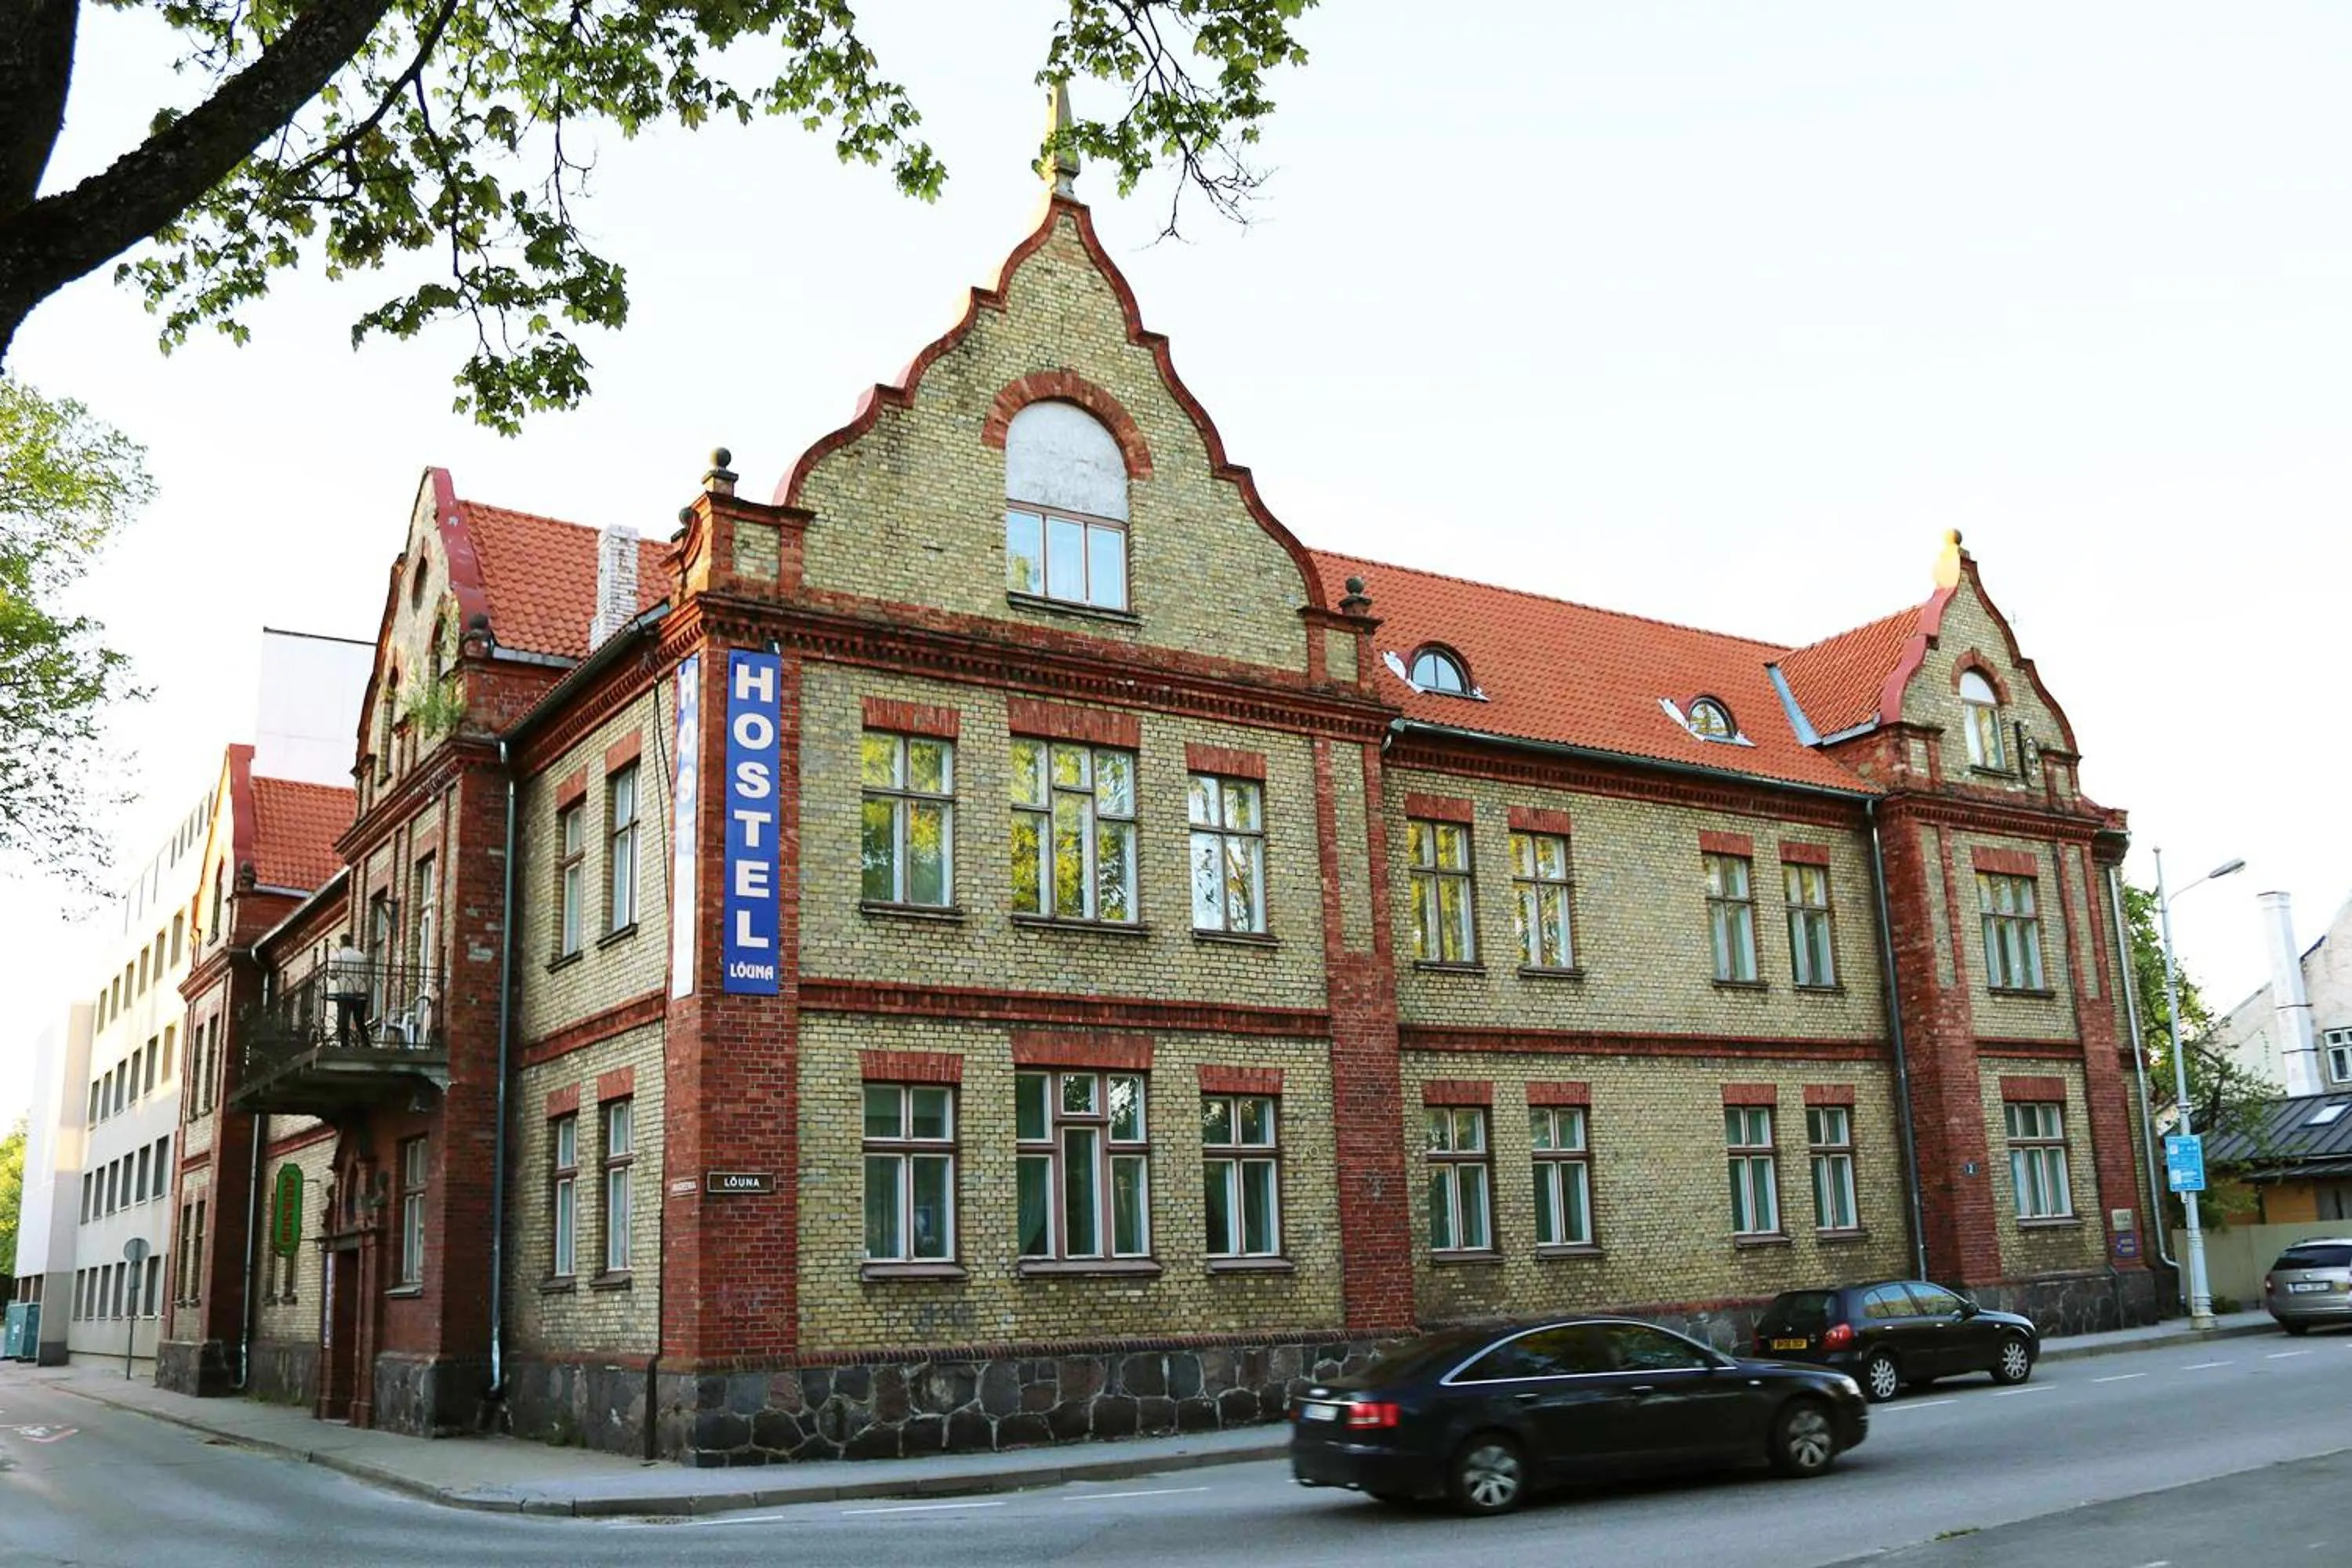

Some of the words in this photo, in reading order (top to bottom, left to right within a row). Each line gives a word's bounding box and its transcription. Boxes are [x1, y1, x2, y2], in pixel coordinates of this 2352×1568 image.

[676, 666, 696, 951] HOST
[733, 665, 774, 948] HOSTEL
[724, 1177, 760, 1188] LÕUNA
